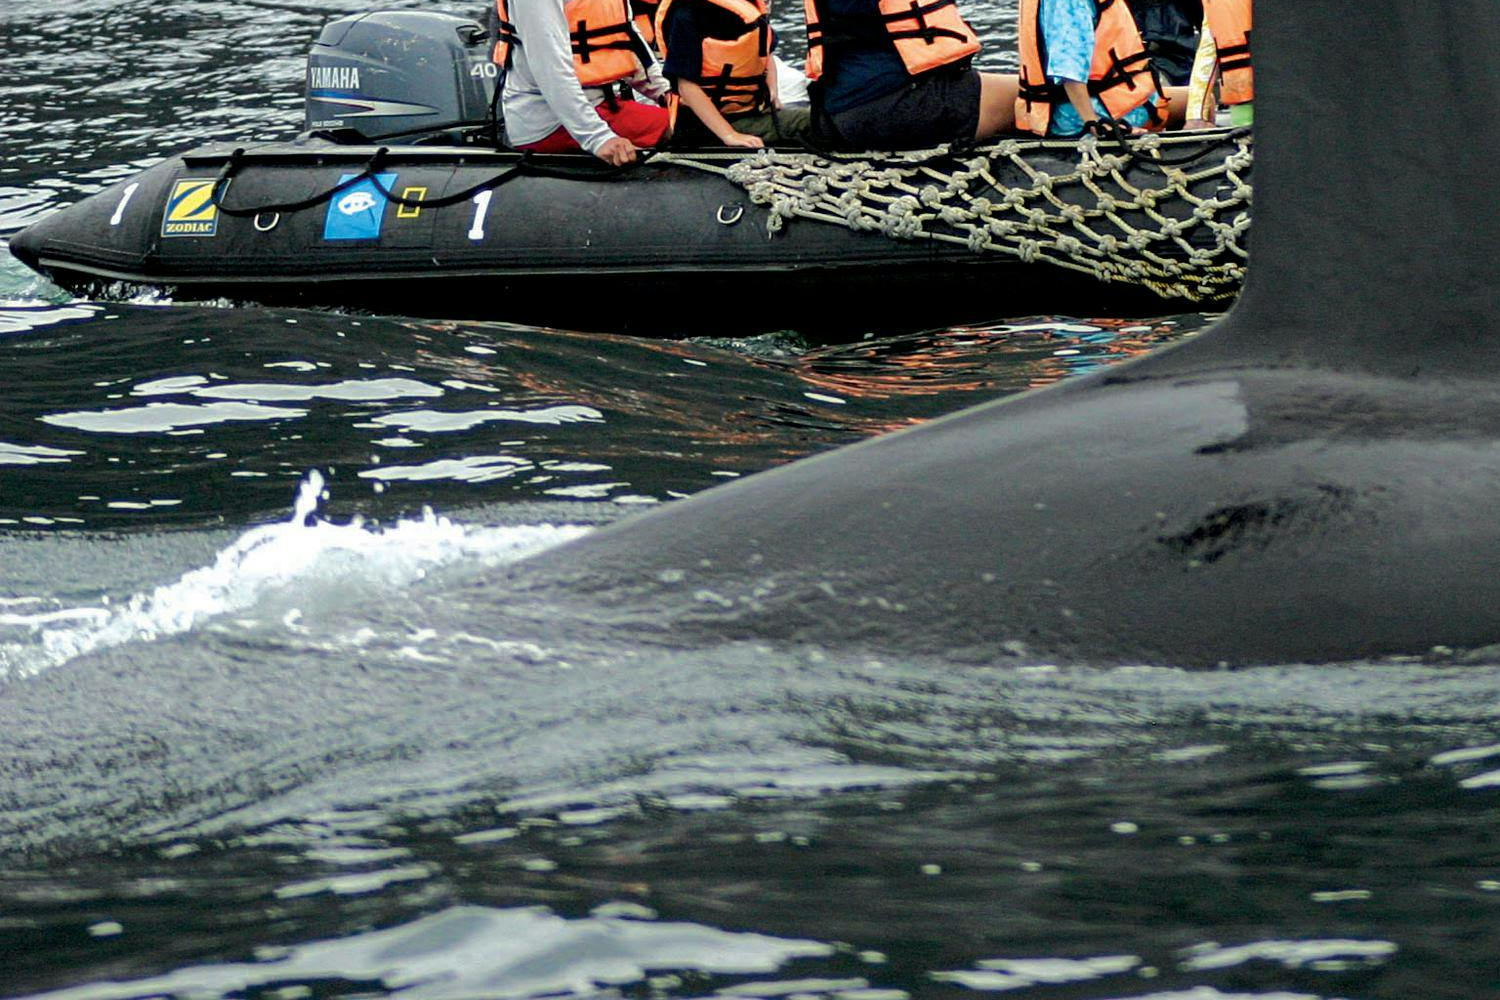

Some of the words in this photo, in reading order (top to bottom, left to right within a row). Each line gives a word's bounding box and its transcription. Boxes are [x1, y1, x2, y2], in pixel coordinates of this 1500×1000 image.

[311, 67, 360, 89] YAMAHA
[470, 63, 497, 78] 40
[110, 183, 139, 225] 1
[468, 190, 493, 240] 1
[166, 222, 213, 233] ZODIAC
